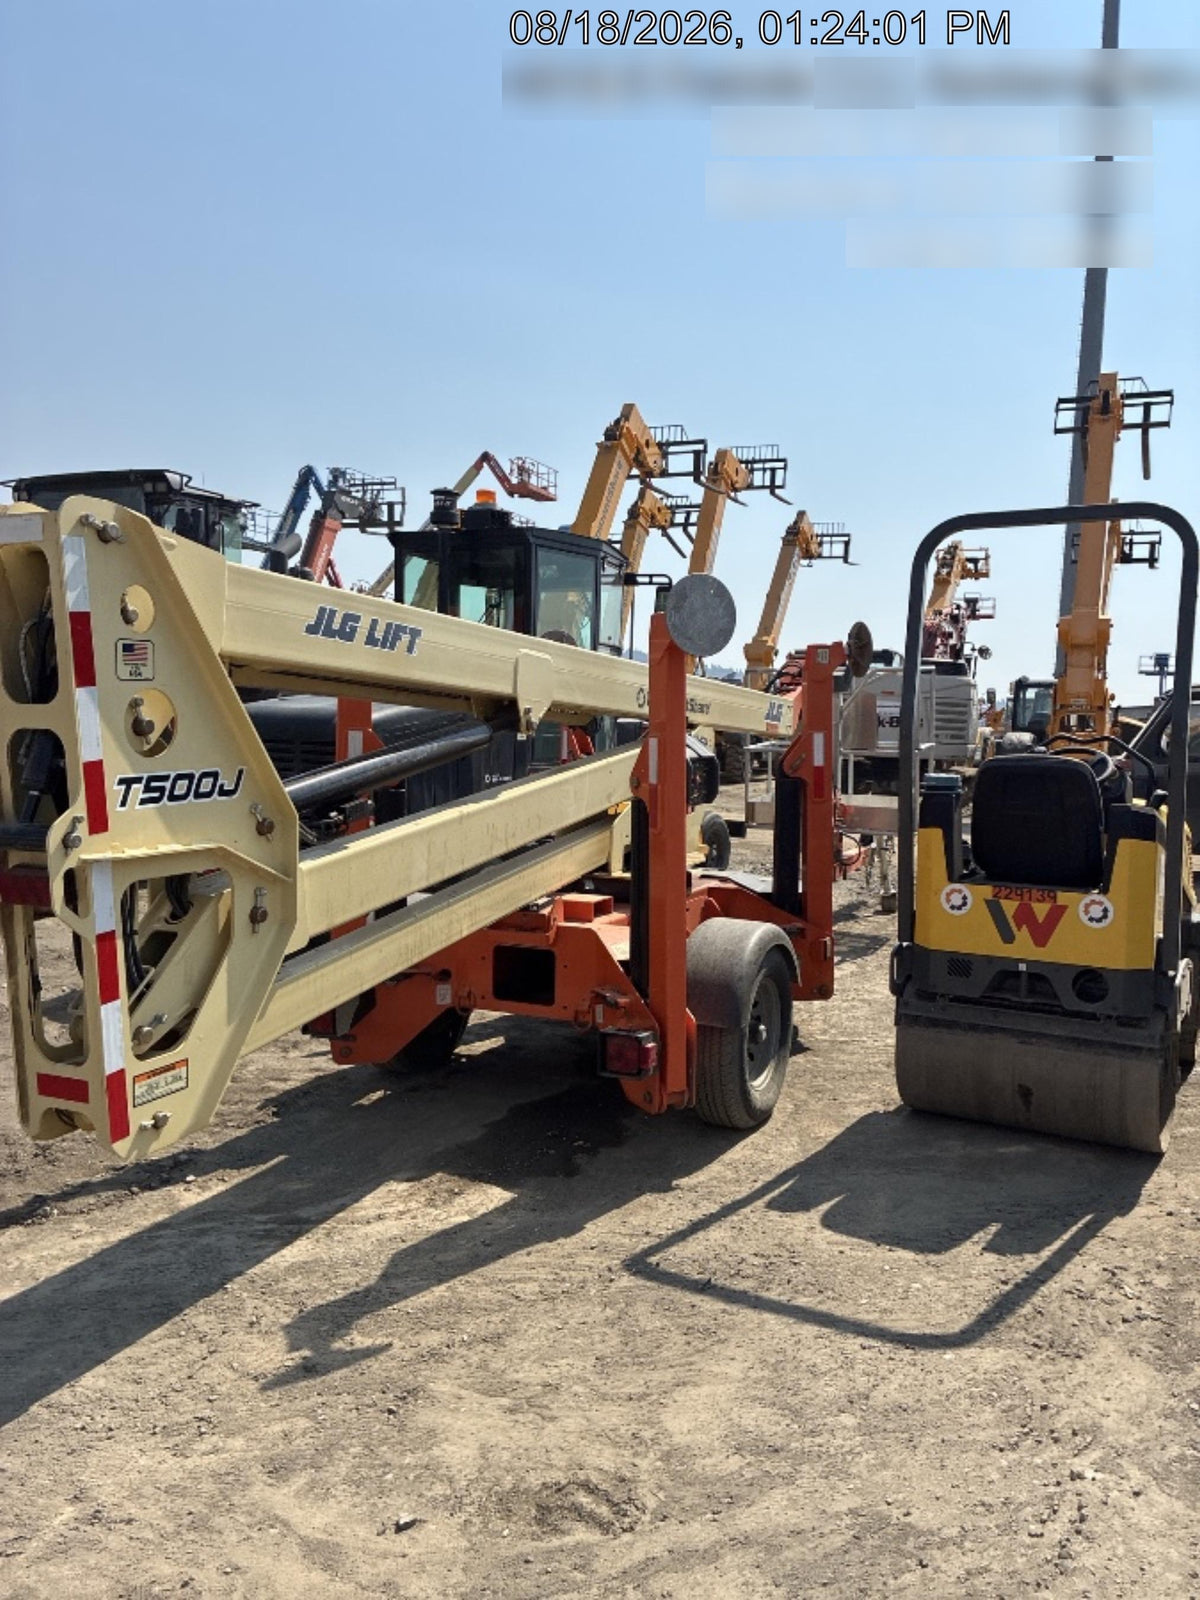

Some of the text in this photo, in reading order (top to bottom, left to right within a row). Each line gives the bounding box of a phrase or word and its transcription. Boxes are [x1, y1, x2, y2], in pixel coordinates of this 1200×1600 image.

[303, 604, 424, 656] JLG LIFT
[764, 700, 784, 724] JLG
[114, 766, 246, 811] T500J
[991, 885, 1057, 904] 229139
